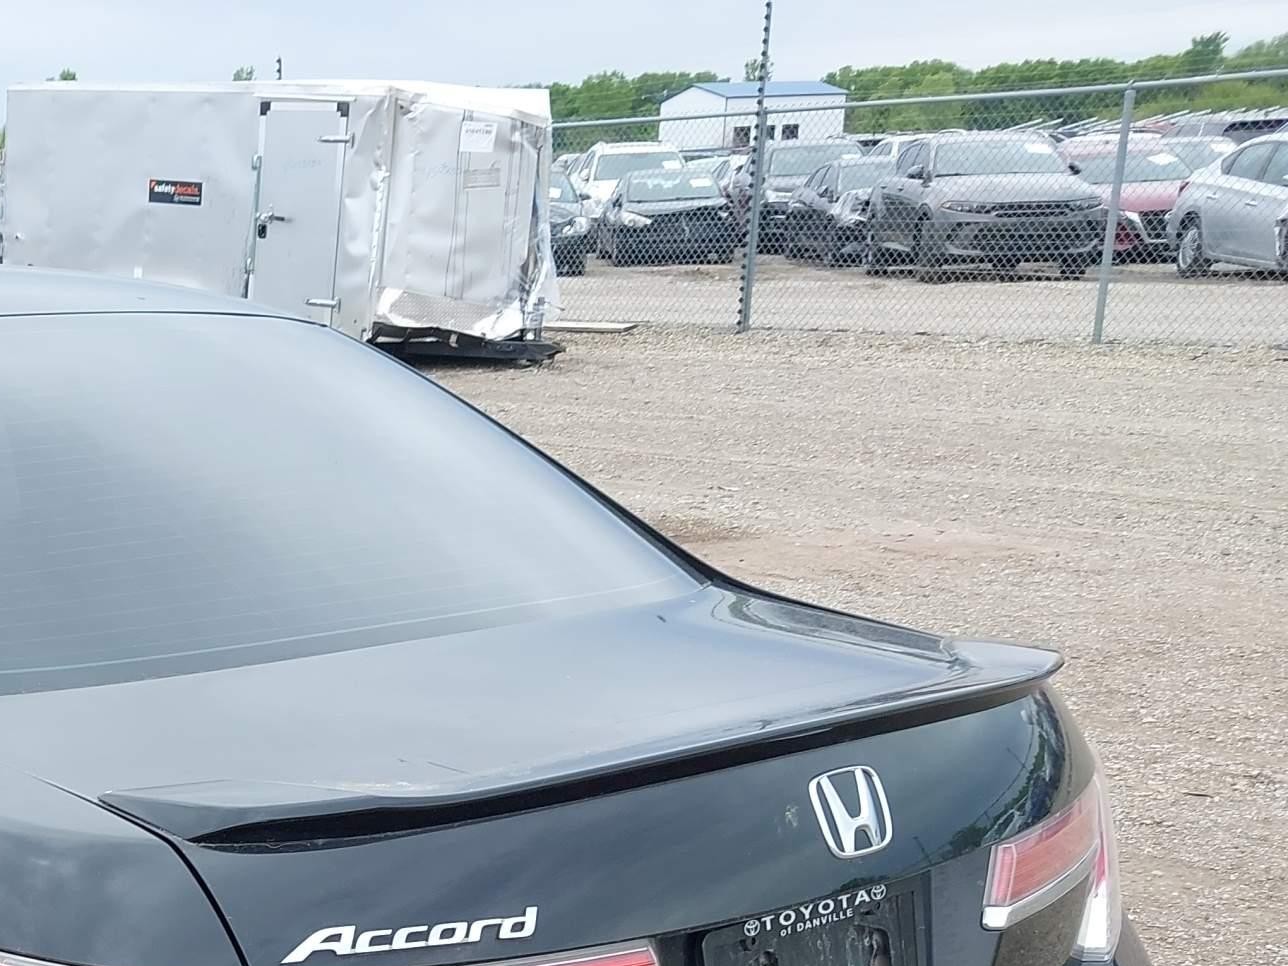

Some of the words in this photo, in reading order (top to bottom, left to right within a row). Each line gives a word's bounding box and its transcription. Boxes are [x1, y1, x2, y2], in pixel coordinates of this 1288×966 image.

[761, 889, 871, 931] TOYOTA
[779, 925, 792, 937] of
[796, 907, 854, 932] DANVILLE
[280, 906, 538, 965] Accord
